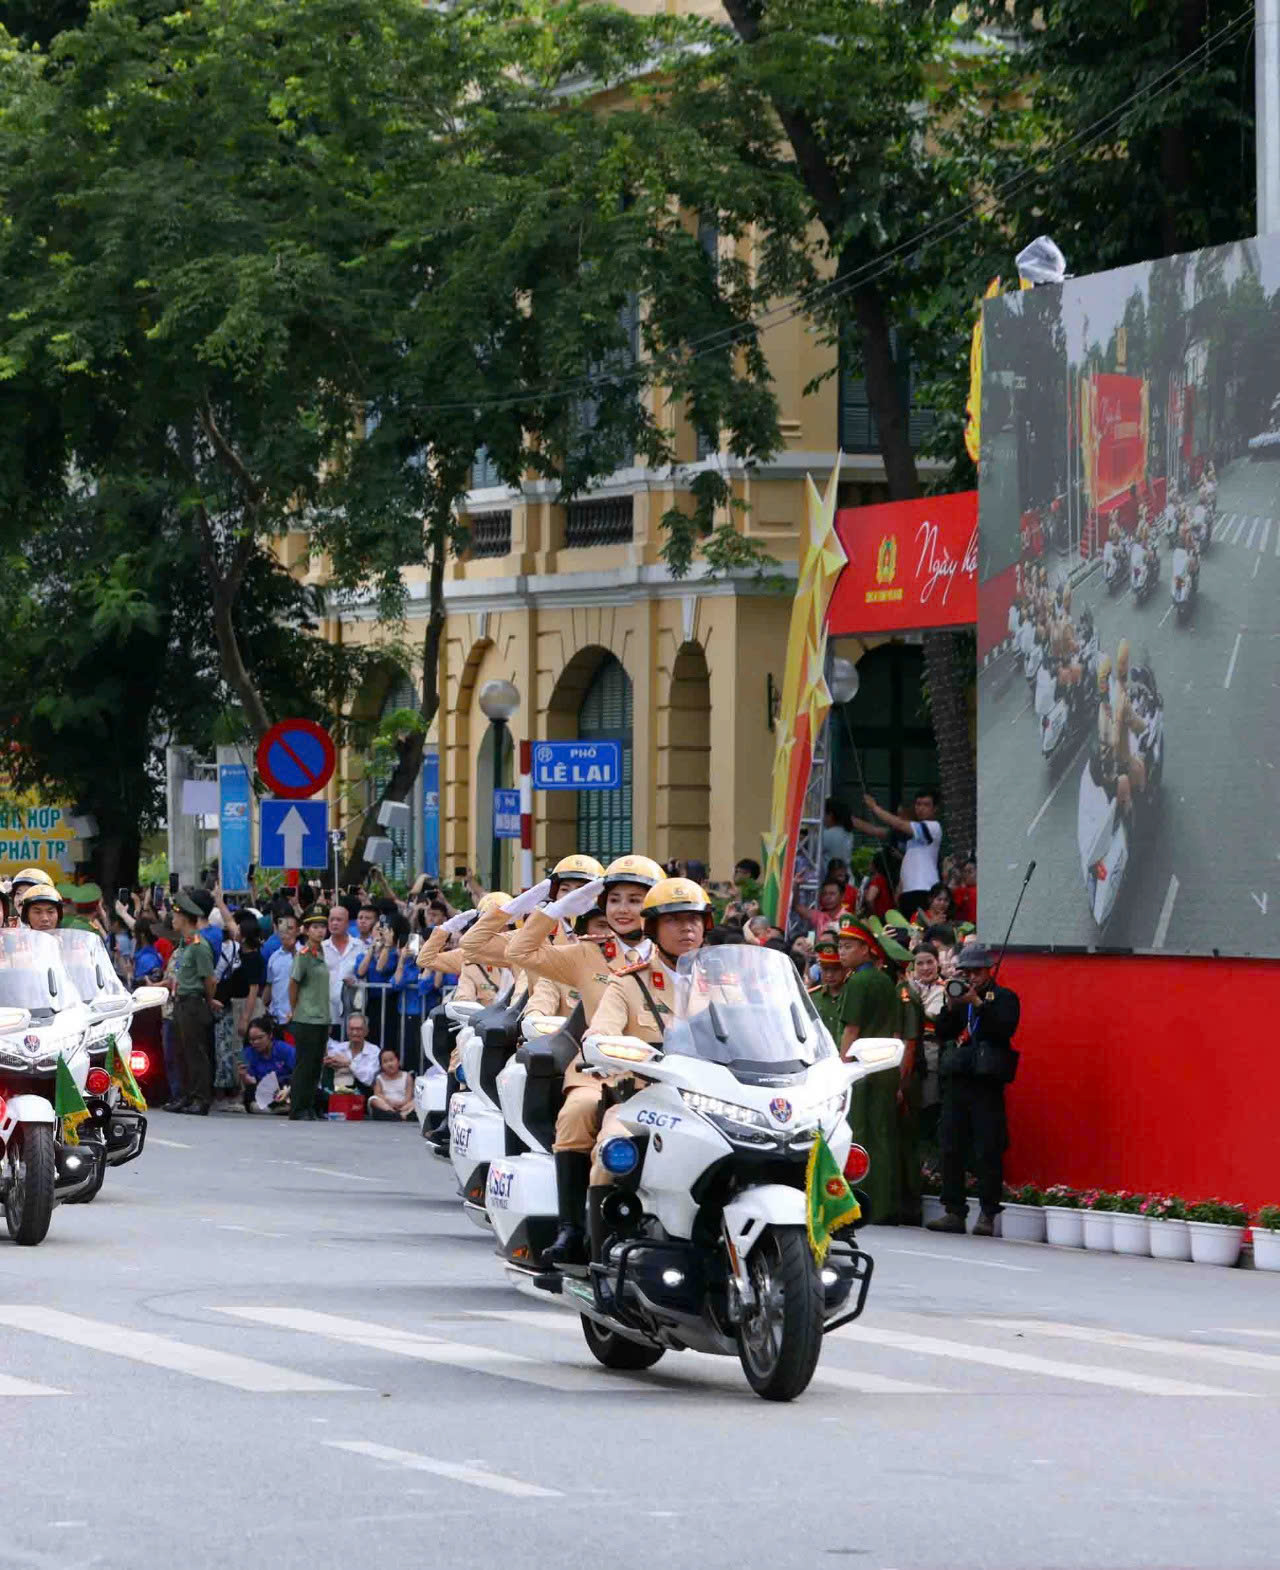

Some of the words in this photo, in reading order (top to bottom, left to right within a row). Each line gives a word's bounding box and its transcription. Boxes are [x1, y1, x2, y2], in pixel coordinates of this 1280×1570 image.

[914, 520, 958, 606] Ngày
[570, 745, 597, 759] PHỐ
[541, 762, 568, 782] LÊ
[572, 765, 611, 782] LAI
[28, 806, 62, 833] HỢP
[636, 1109, 682, 1130] CSGT
